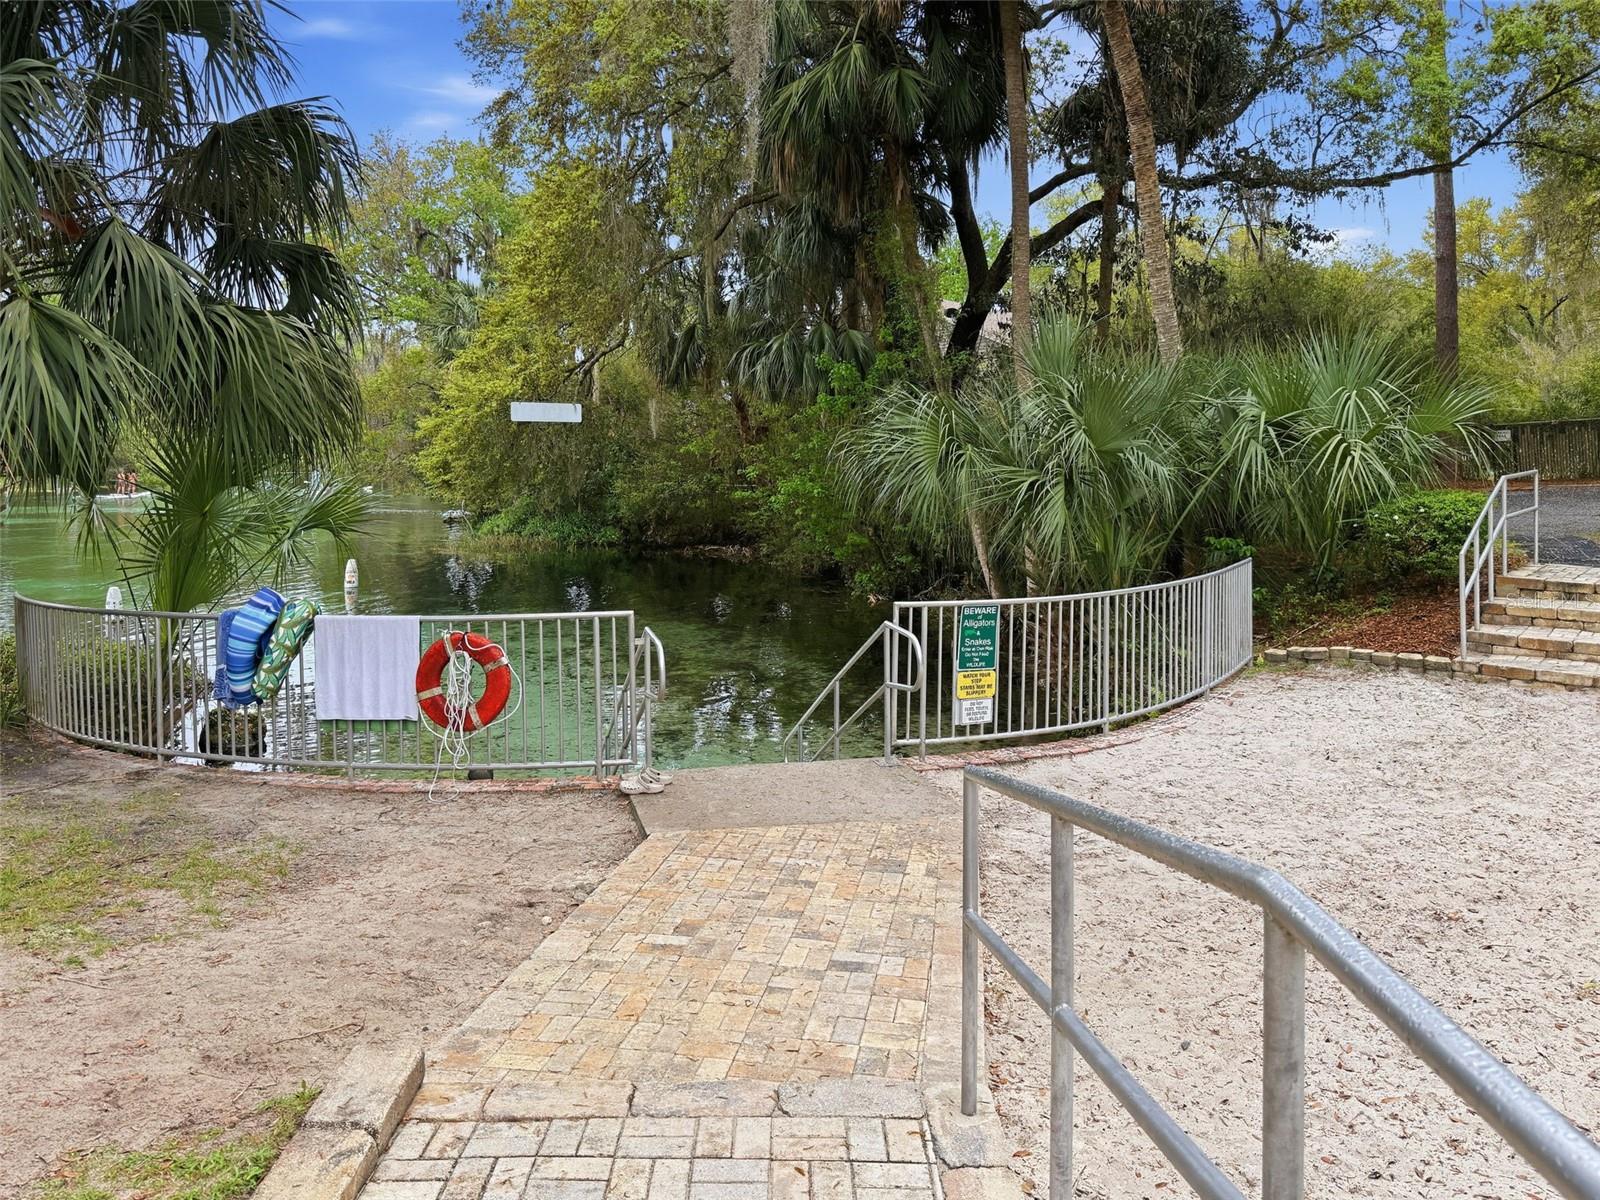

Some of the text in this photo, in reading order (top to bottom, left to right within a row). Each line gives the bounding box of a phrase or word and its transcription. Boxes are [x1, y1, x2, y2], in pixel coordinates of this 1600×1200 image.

[964, 607, 997, 615] BEWARE
[963, 619, 996, 628] Alligators
[964, 638, 992, 646] Snakes
